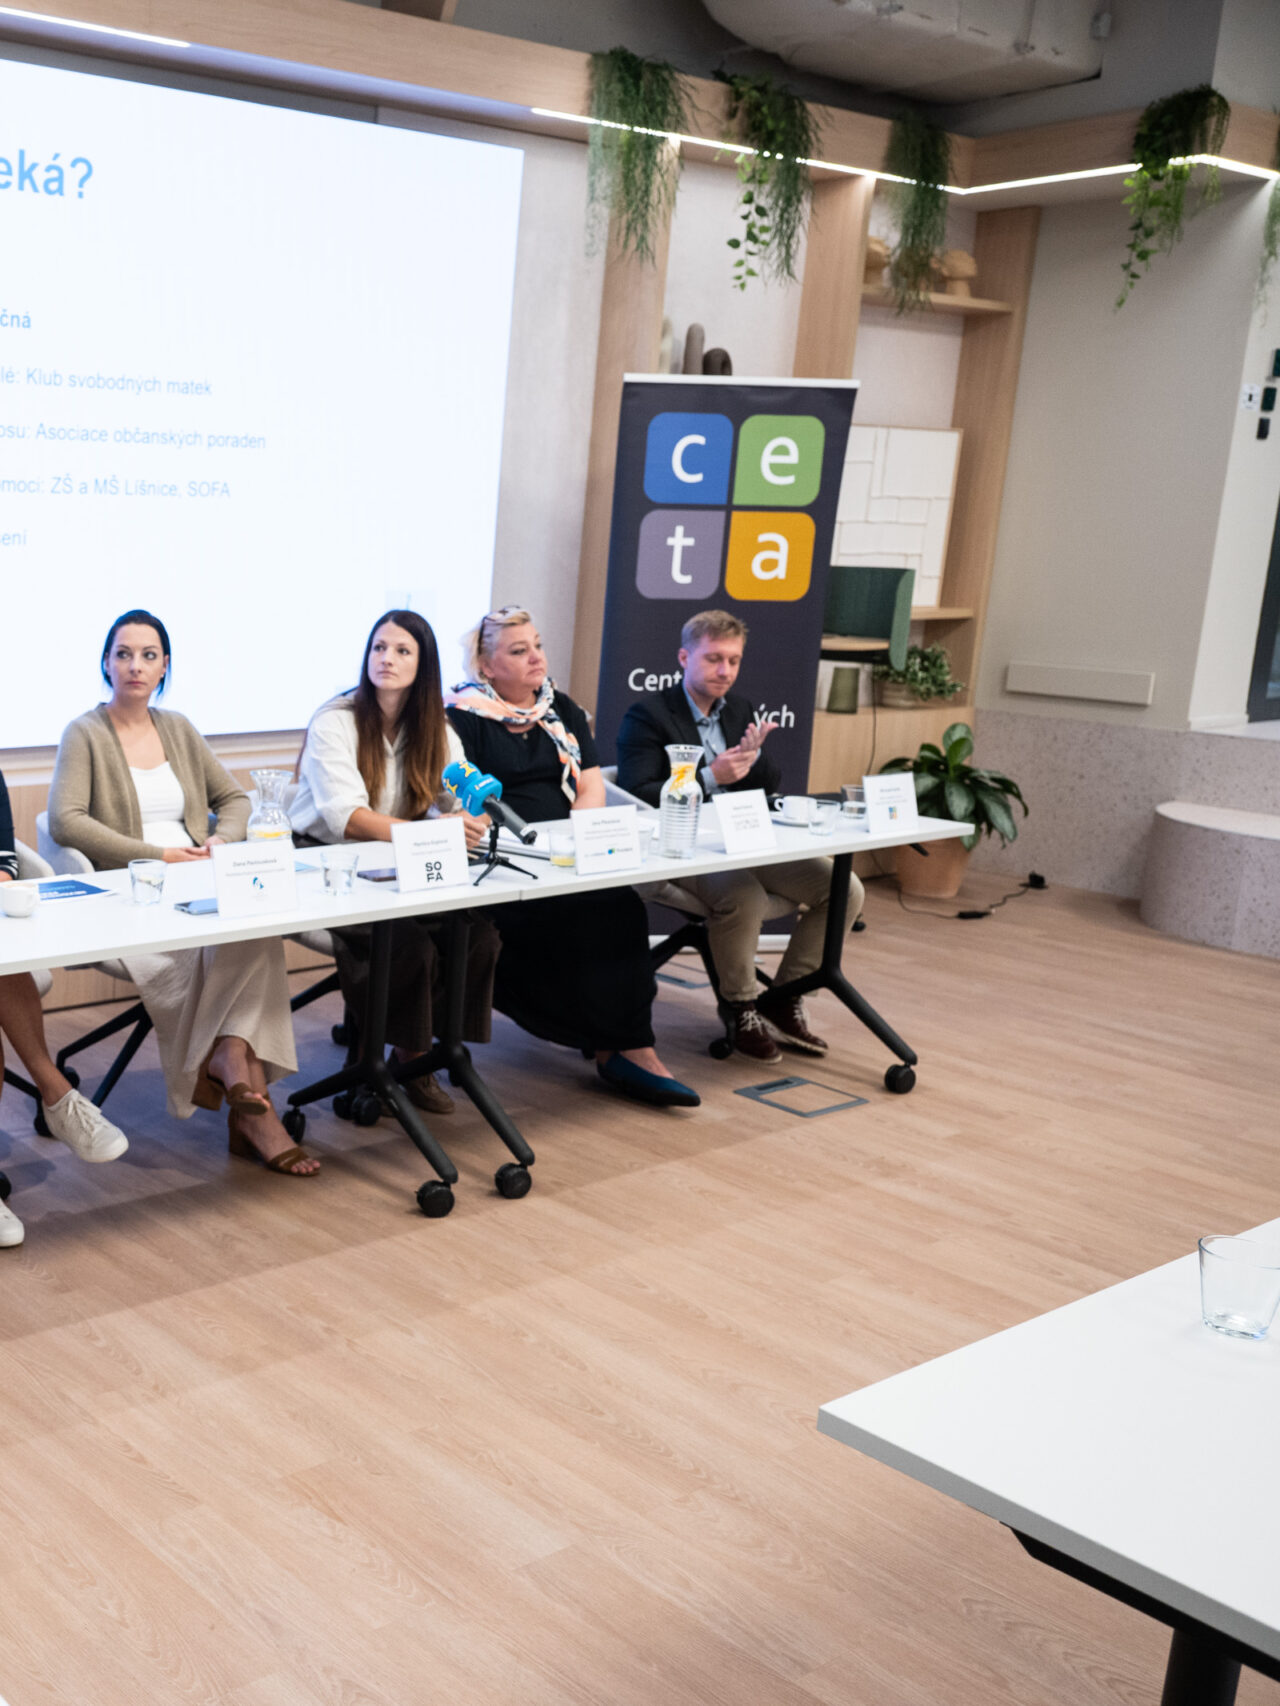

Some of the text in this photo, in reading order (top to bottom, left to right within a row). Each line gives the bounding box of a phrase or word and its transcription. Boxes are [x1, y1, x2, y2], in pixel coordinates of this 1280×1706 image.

[25, 367, 63, 387] Klub
[67, 370, 161, 395] svobodných
[165, 379, 212, 395] matek
[34, 421, 108, 443] Asociace
[112, 425, 202, 449] občanských
[206, 431, 266, 450] poraden
[49, 472, 73, 494] ZŠ
[77, 481, 88, 495] a
[93, 473, 120, 496] MŠ
[186, 479, 230, 498] SOFA
[627, 668, 682, 691] Cent
[753, 703, 795, 731] ých
